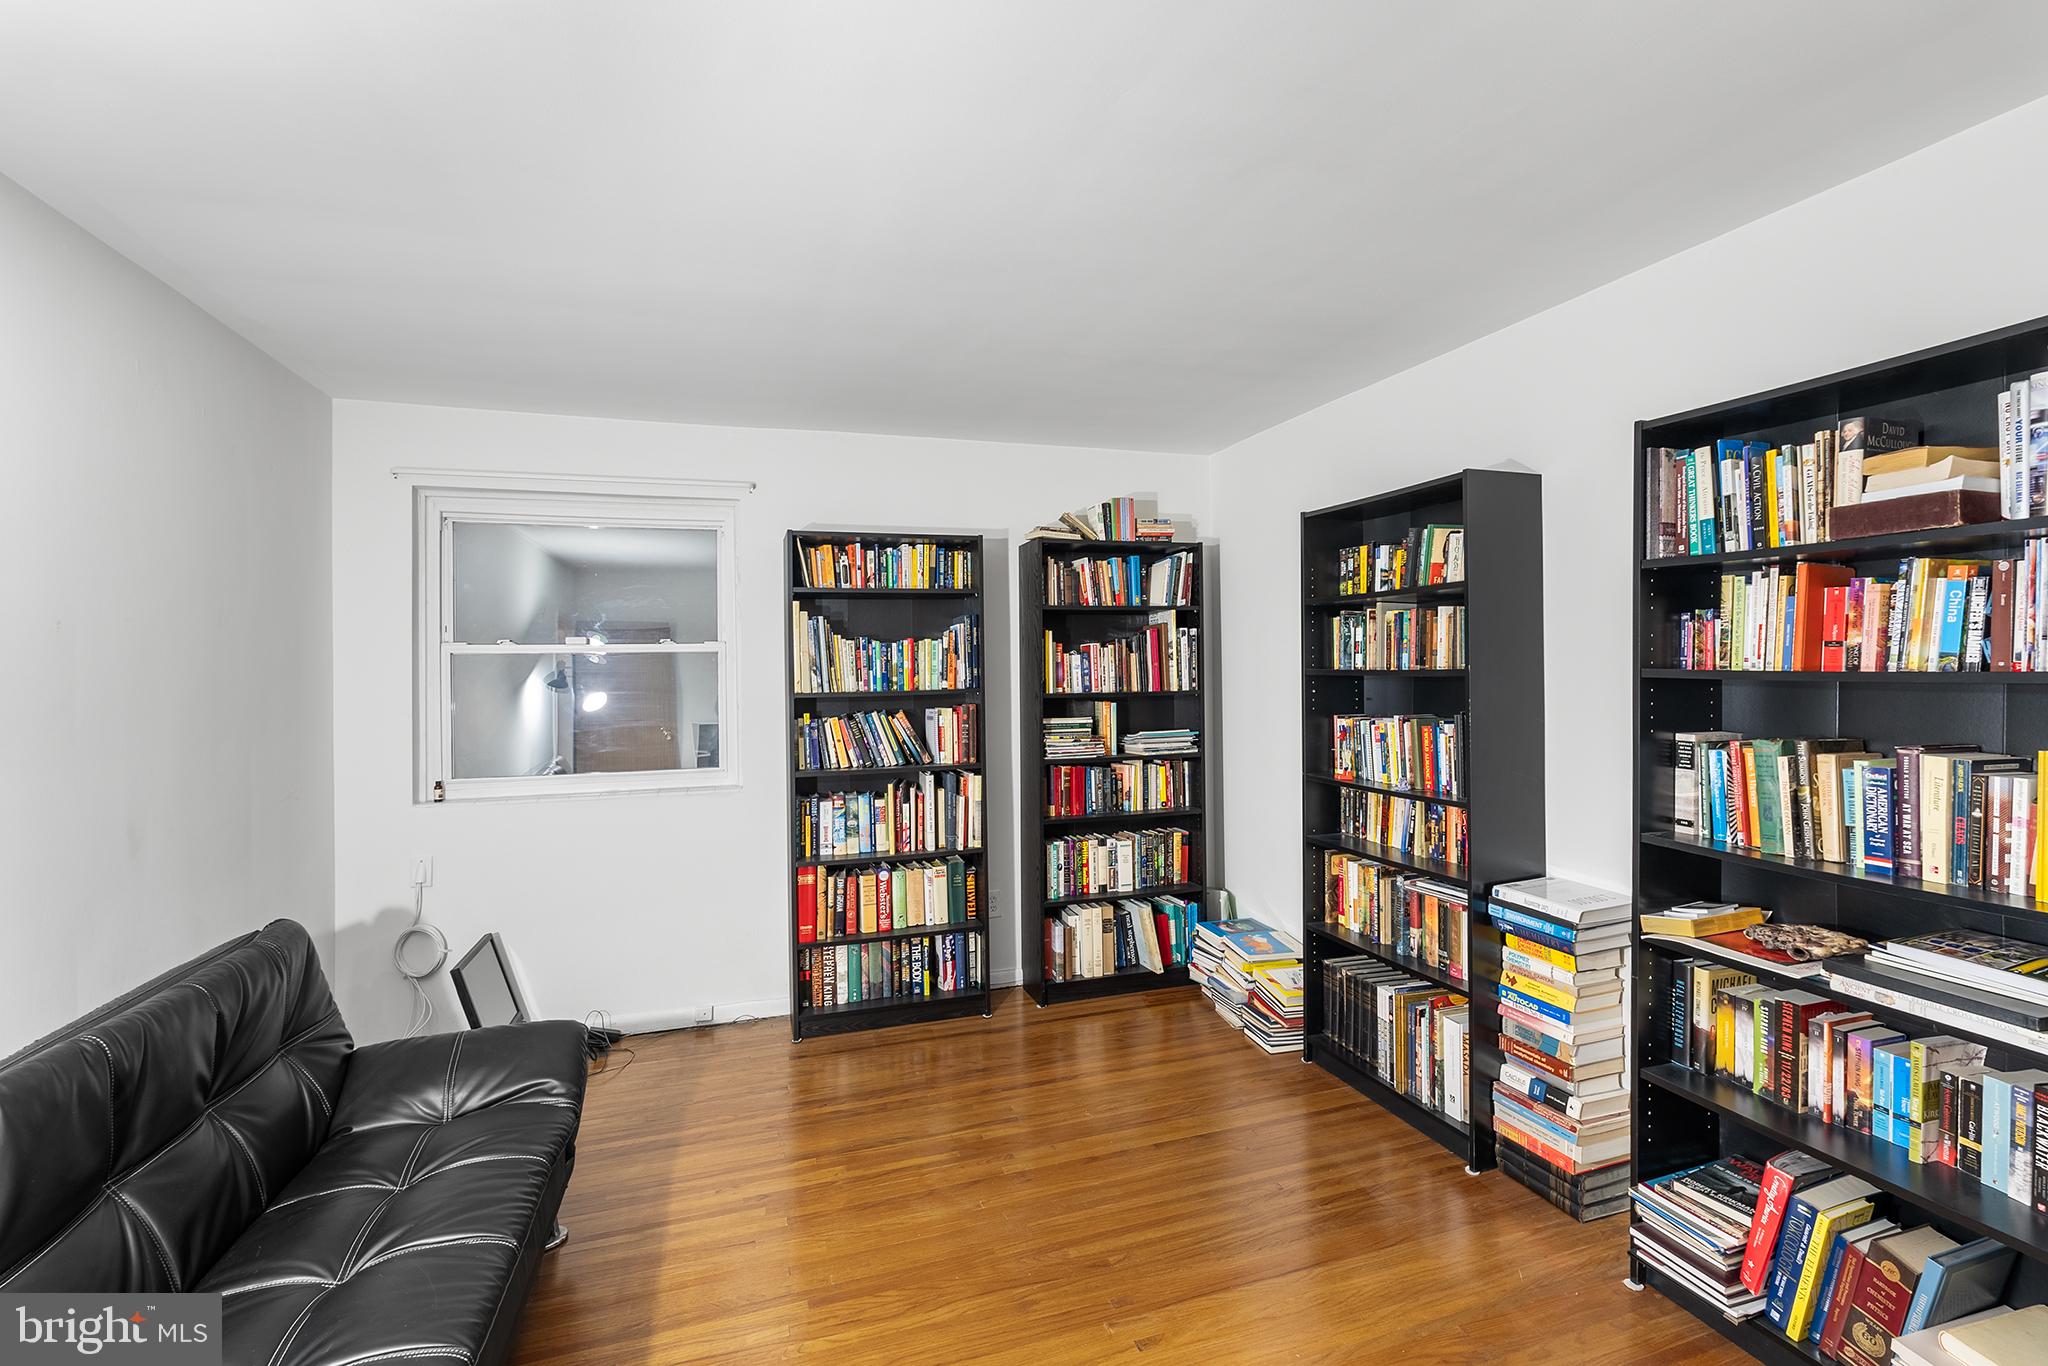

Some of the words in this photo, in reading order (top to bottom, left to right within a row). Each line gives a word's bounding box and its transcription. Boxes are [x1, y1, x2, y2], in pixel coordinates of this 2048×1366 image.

[1882, 422, 1905, 437] DAVID
[1687, 466, 1696, 487] GREAT
[1753, 470, 1762, 489] CIVIL
[1688, 489, 1696, 523] THINKERS
[1754, 493, 1762, 520] ACTION
[1946, 590, 1962, 623] China
[1968, 592, 1986, 629] LUCIFER'S
[1966, 631, 1982, 663] HAMMER
[1798, 756, 1807, 785] SUMMONS
[1933, 776, 1944, 812] Literature
[1801, 804, 1810, 819] JOHN
[1866, 786, 1877, 833] DICTIONARY
[1877, 787, 1888, 834] AMERICAN
[1902, 803, 1911, 813] AT
[1903, 814, 1912, 828] WAR
[1956, 816, 1966, 844] CHAOS
[1802, 820, 1812, 848] GRISHAM
[1903, 830, 1912, 839] AT
[1903, 841, 1912, 854] SEA
[912, 945, 921, 961] THE
[912, 962, 921, 982] BODY
[824, 986, 832, 1006] KING
[1675, 980, 1684, 998] NEAL
[1507, 994, 1539, 1012] AUTOCAD
[1674, 1001, 1684, 1048] STEPHENSON
[1760, 1005, 1768, 1035] STEPHEN
[1782, 1002, 1793, 1034] STEPHEN
[1782, 1034, 1792, 1052] KING
[1781, 1060, 1791, 1098] 11/22/63
[2035, 1104, 2048, 1170] BLACKWATER
[1711, 1163, 1725, 1172] THE
[1724, 1168, 1742, 1180] ROAD
[1776, 1217, 1805, 1279] TOXICOLOGY
[1798, 1258, 1814, 1301] ELEMENTS
[1872, 1276, 1897, 1297] HANDBOOK
[1866, 1286, 1896, 1311] CHEMISTRY
[1866, 1301, 1889, 1321] PHYSICS
[1862, 1333, 1877, 1346] 60
